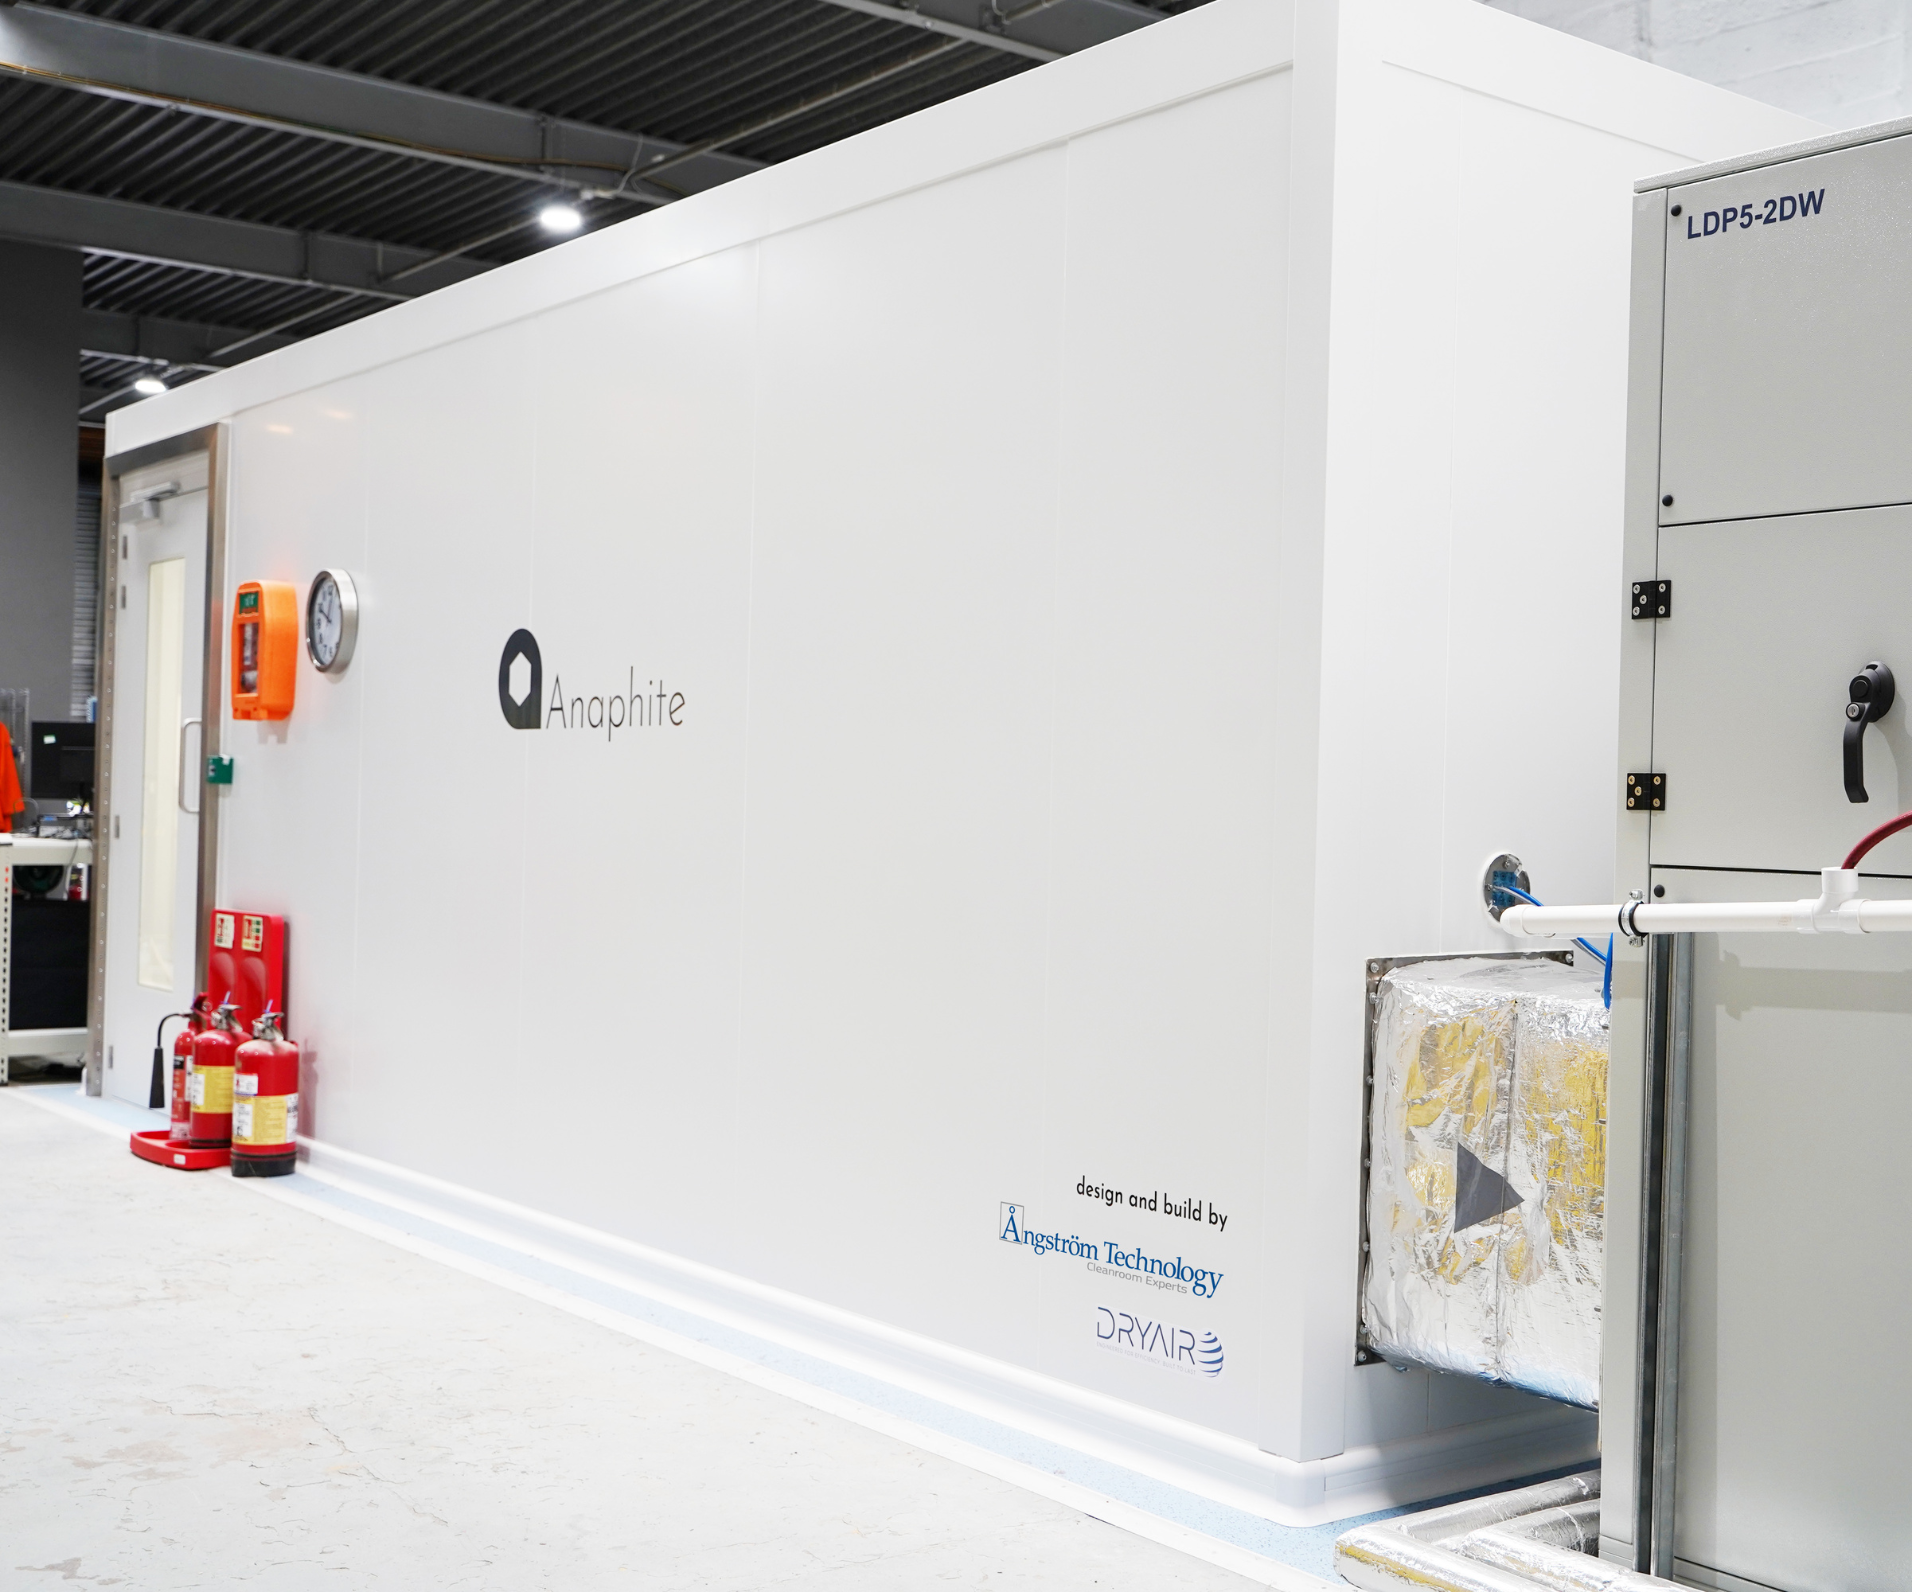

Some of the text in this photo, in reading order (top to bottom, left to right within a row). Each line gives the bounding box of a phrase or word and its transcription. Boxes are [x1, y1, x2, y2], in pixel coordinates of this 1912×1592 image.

[1687, 188, 1826, 240] LDP5-2DW
[546, 665, 686, 742] Anaphite
[1076, 1175, 1228, 1232] design and build by
[1000, 1205, 1224, 1299] Ångström Technology
[1086, 1261, 1188, 1295] Cleanroom Experts
[1096, 1306, 1196, 1366] DRYAIR
